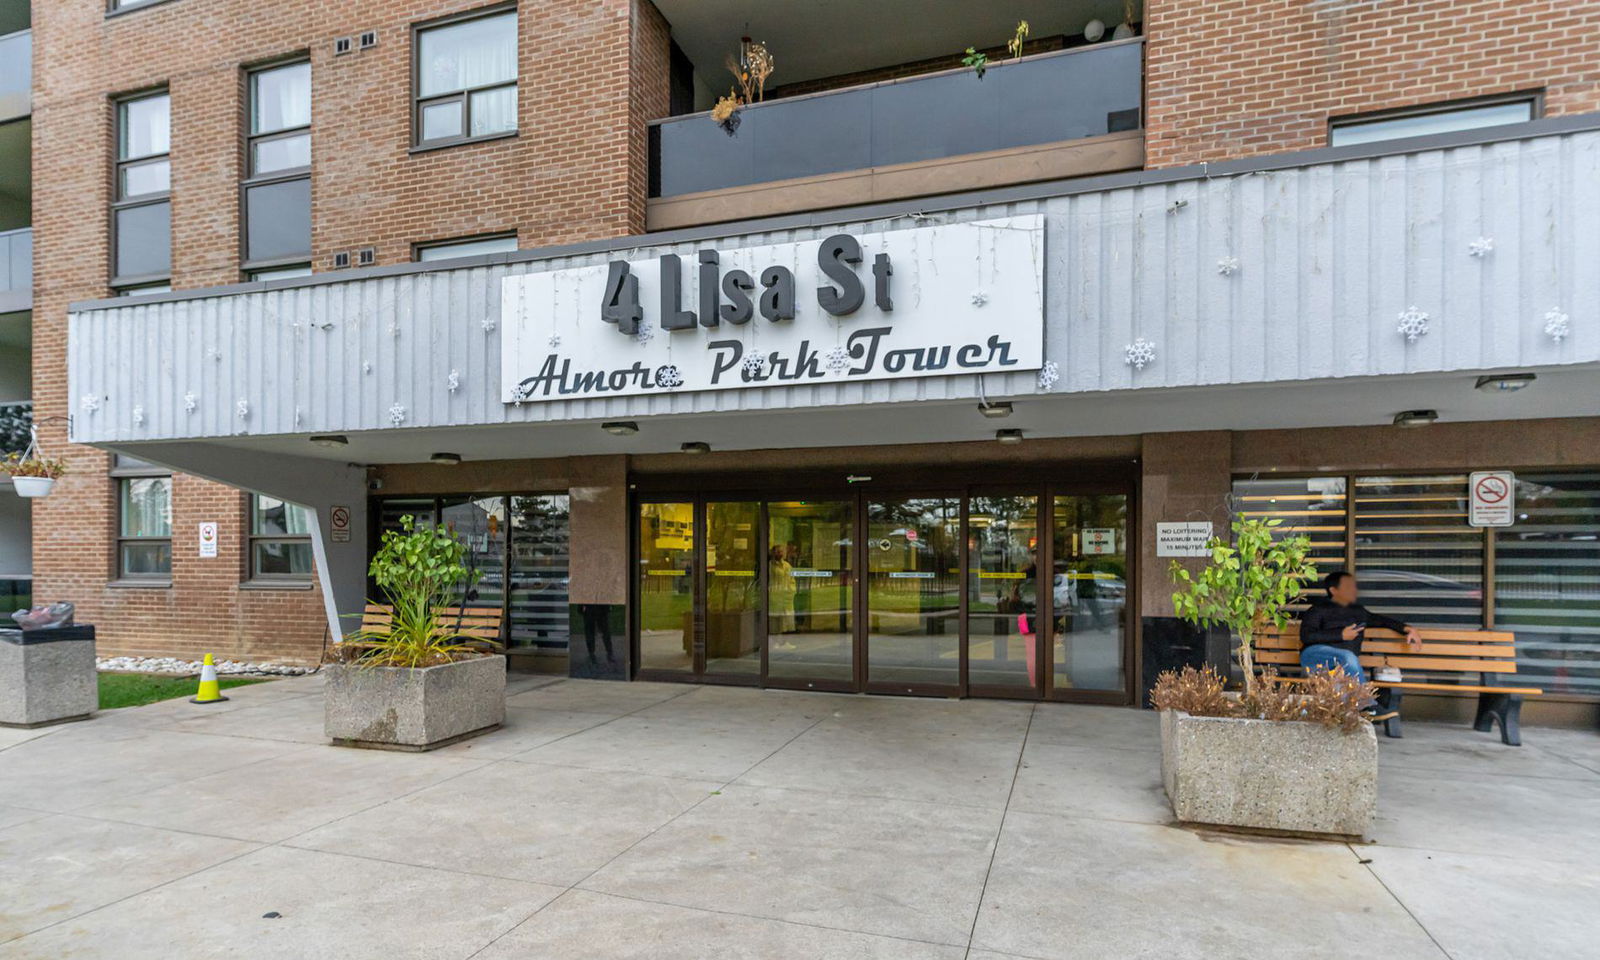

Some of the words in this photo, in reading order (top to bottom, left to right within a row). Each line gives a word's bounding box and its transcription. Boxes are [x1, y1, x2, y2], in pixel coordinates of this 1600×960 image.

[601, 260, 643, 335] 4
[660, 249, 796, 330] Lisa
[817, 233, 893, 316] St
[708, 340, 825, 384] Park
[847, 327, 1018, 376] Tower
